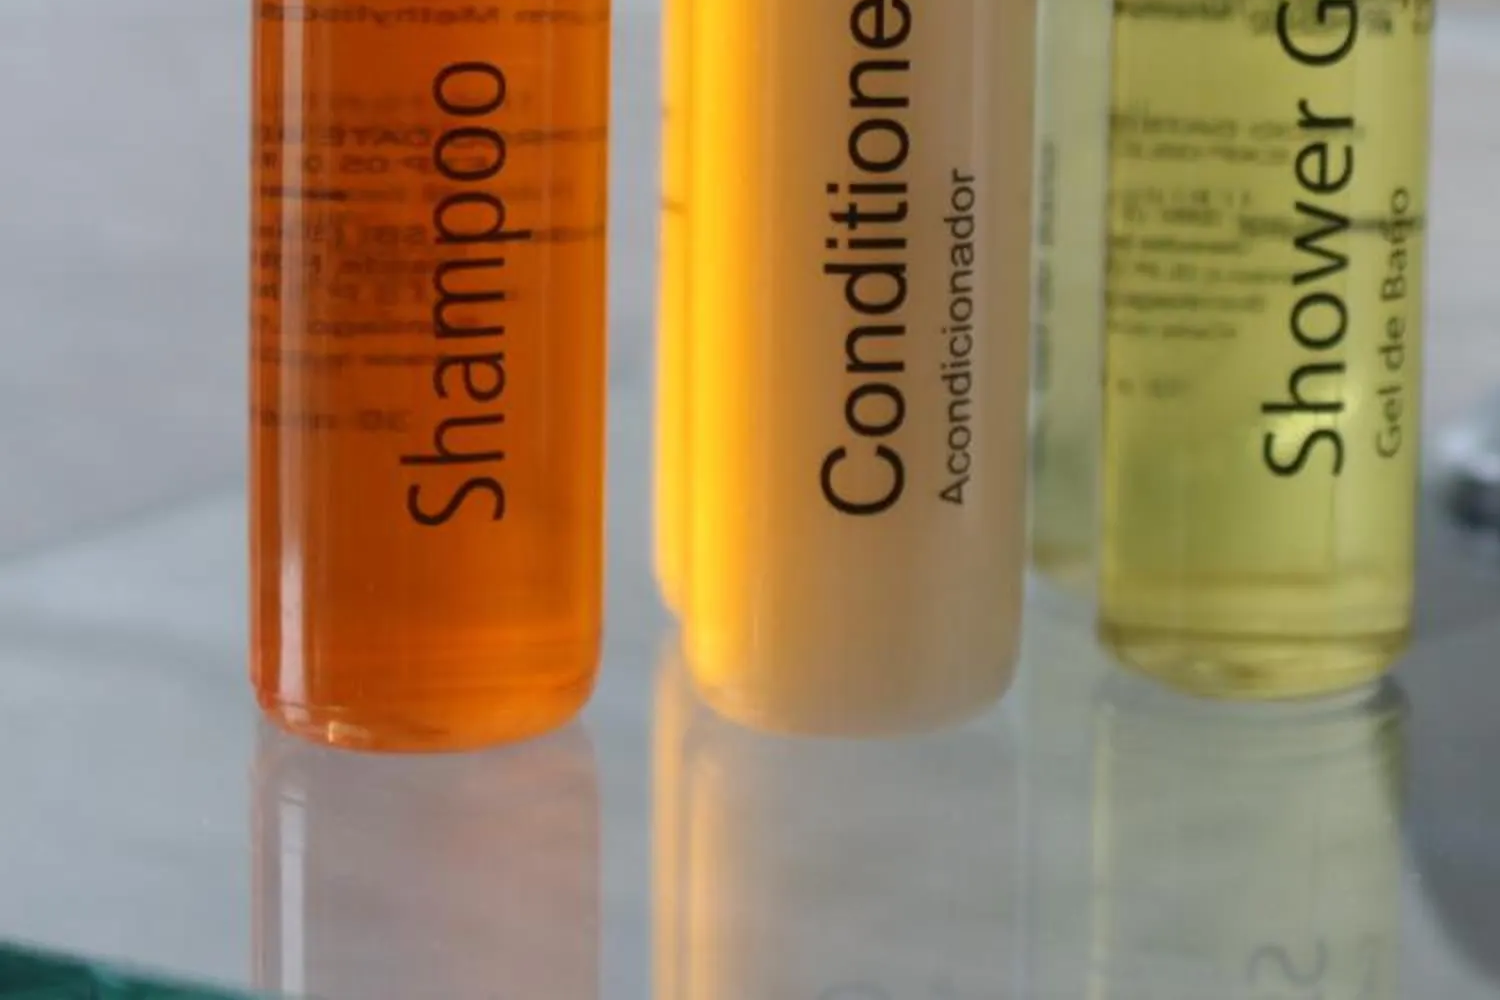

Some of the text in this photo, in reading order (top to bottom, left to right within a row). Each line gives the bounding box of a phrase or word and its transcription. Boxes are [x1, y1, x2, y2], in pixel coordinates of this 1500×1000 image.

[400, 61, 532, 526] Shampoo
[938, 168, 977, 505] Acondicionador
[1262, 98, 1355, 477] Shower
[1376, 386, 1402, 458] Gel
[1379, 317, 1404, 370] de
